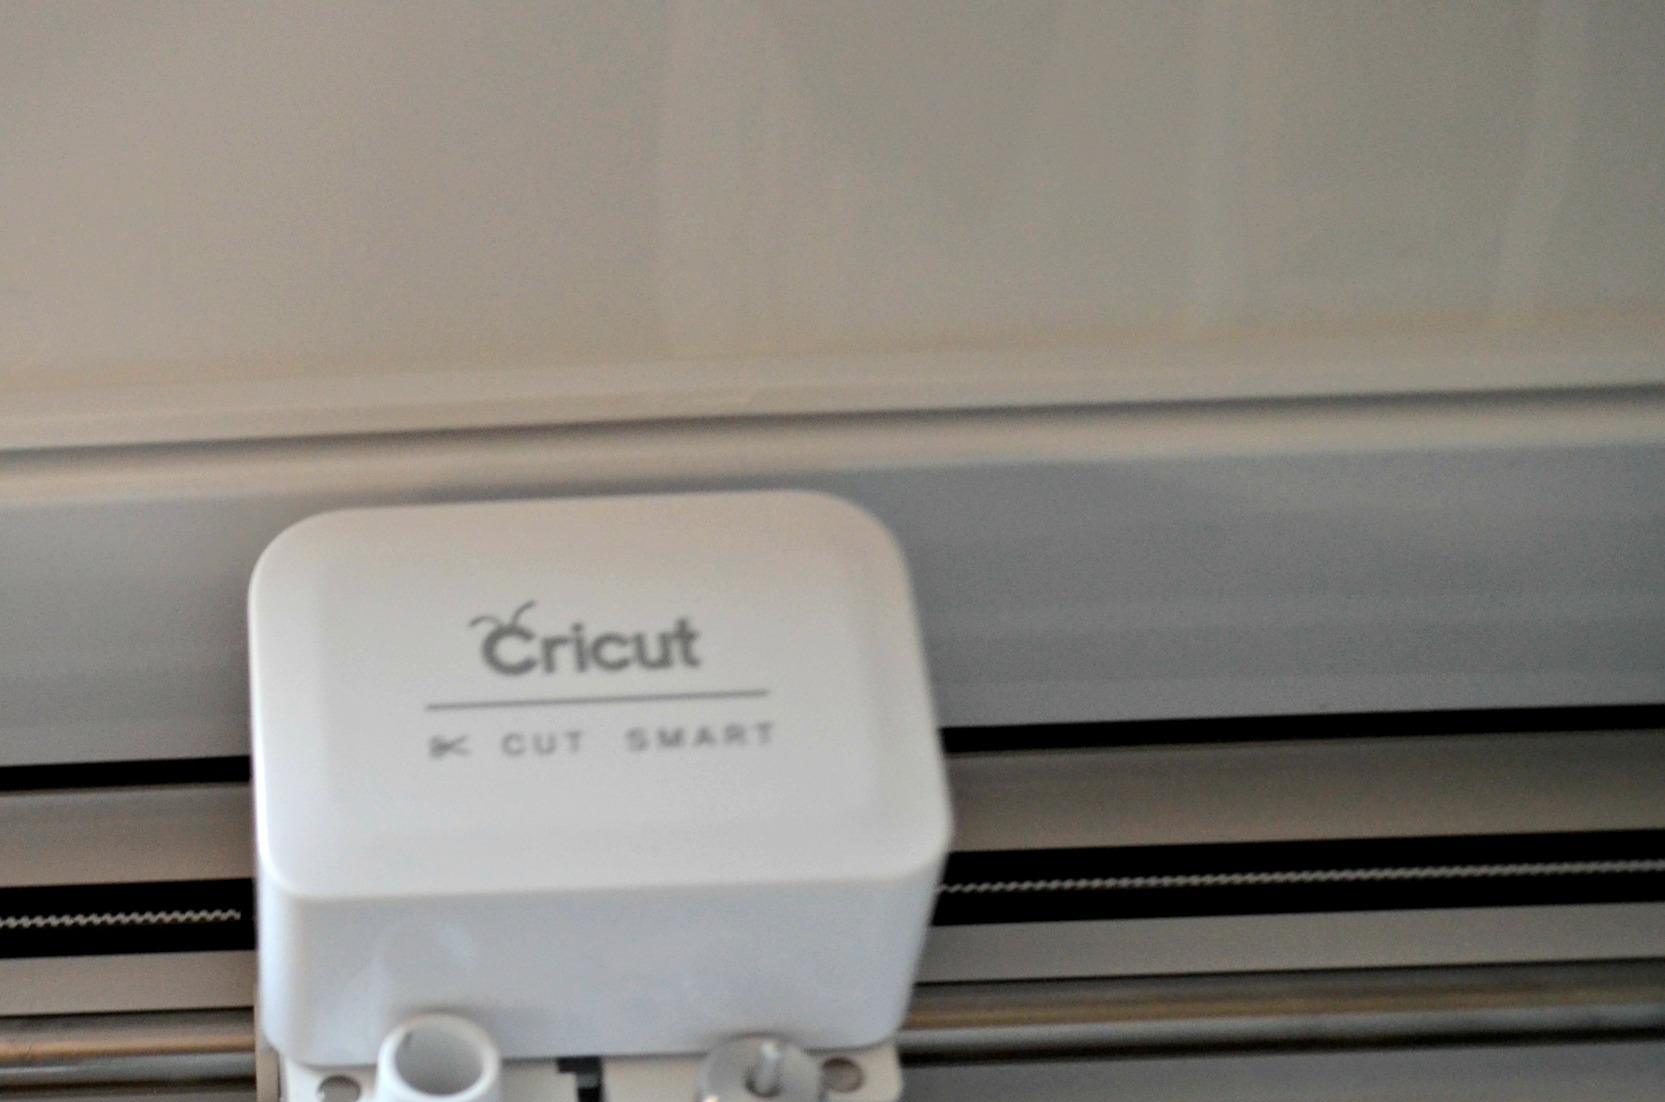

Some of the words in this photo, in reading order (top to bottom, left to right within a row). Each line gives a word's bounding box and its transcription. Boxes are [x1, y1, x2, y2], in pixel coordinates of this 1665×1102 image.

[470, 603, 701, 675] Cricut
[500, 730, 585, 756] CUT
[624, 722, 775, 752] SMART
